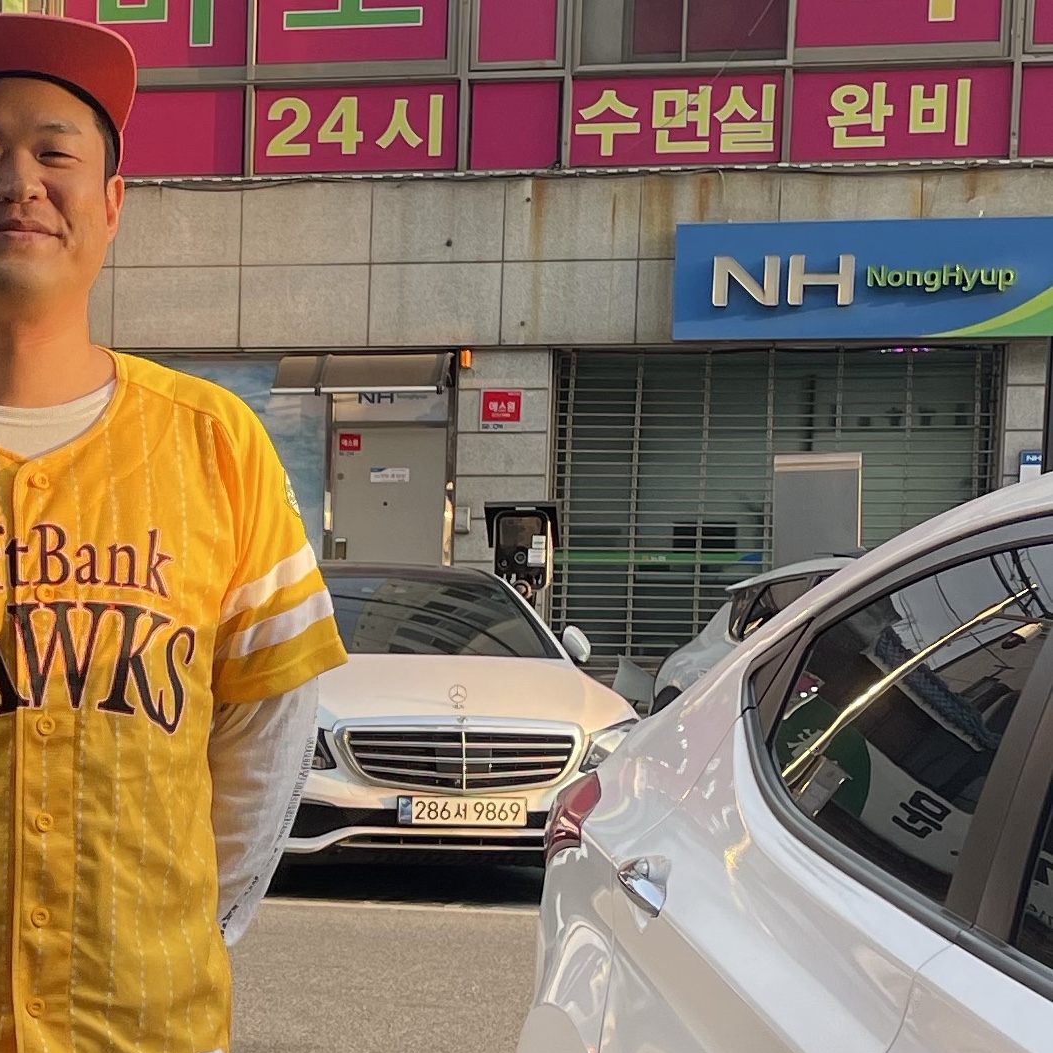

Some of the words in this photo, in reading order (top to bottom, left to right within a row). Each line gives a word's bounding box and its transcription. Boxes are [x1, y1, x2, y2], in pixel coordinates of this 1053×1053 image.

[266, 94, 444, 156] 24시
[575, 84, 777, 156] 수면실
[827, 78, 972, 149] 완비
[712, 255, 855, 307] NH
[866, 264, 1017, 293] NongHyup
[414, 800, 468, 821] 286서
[473, 801, 522, 822] 9869
